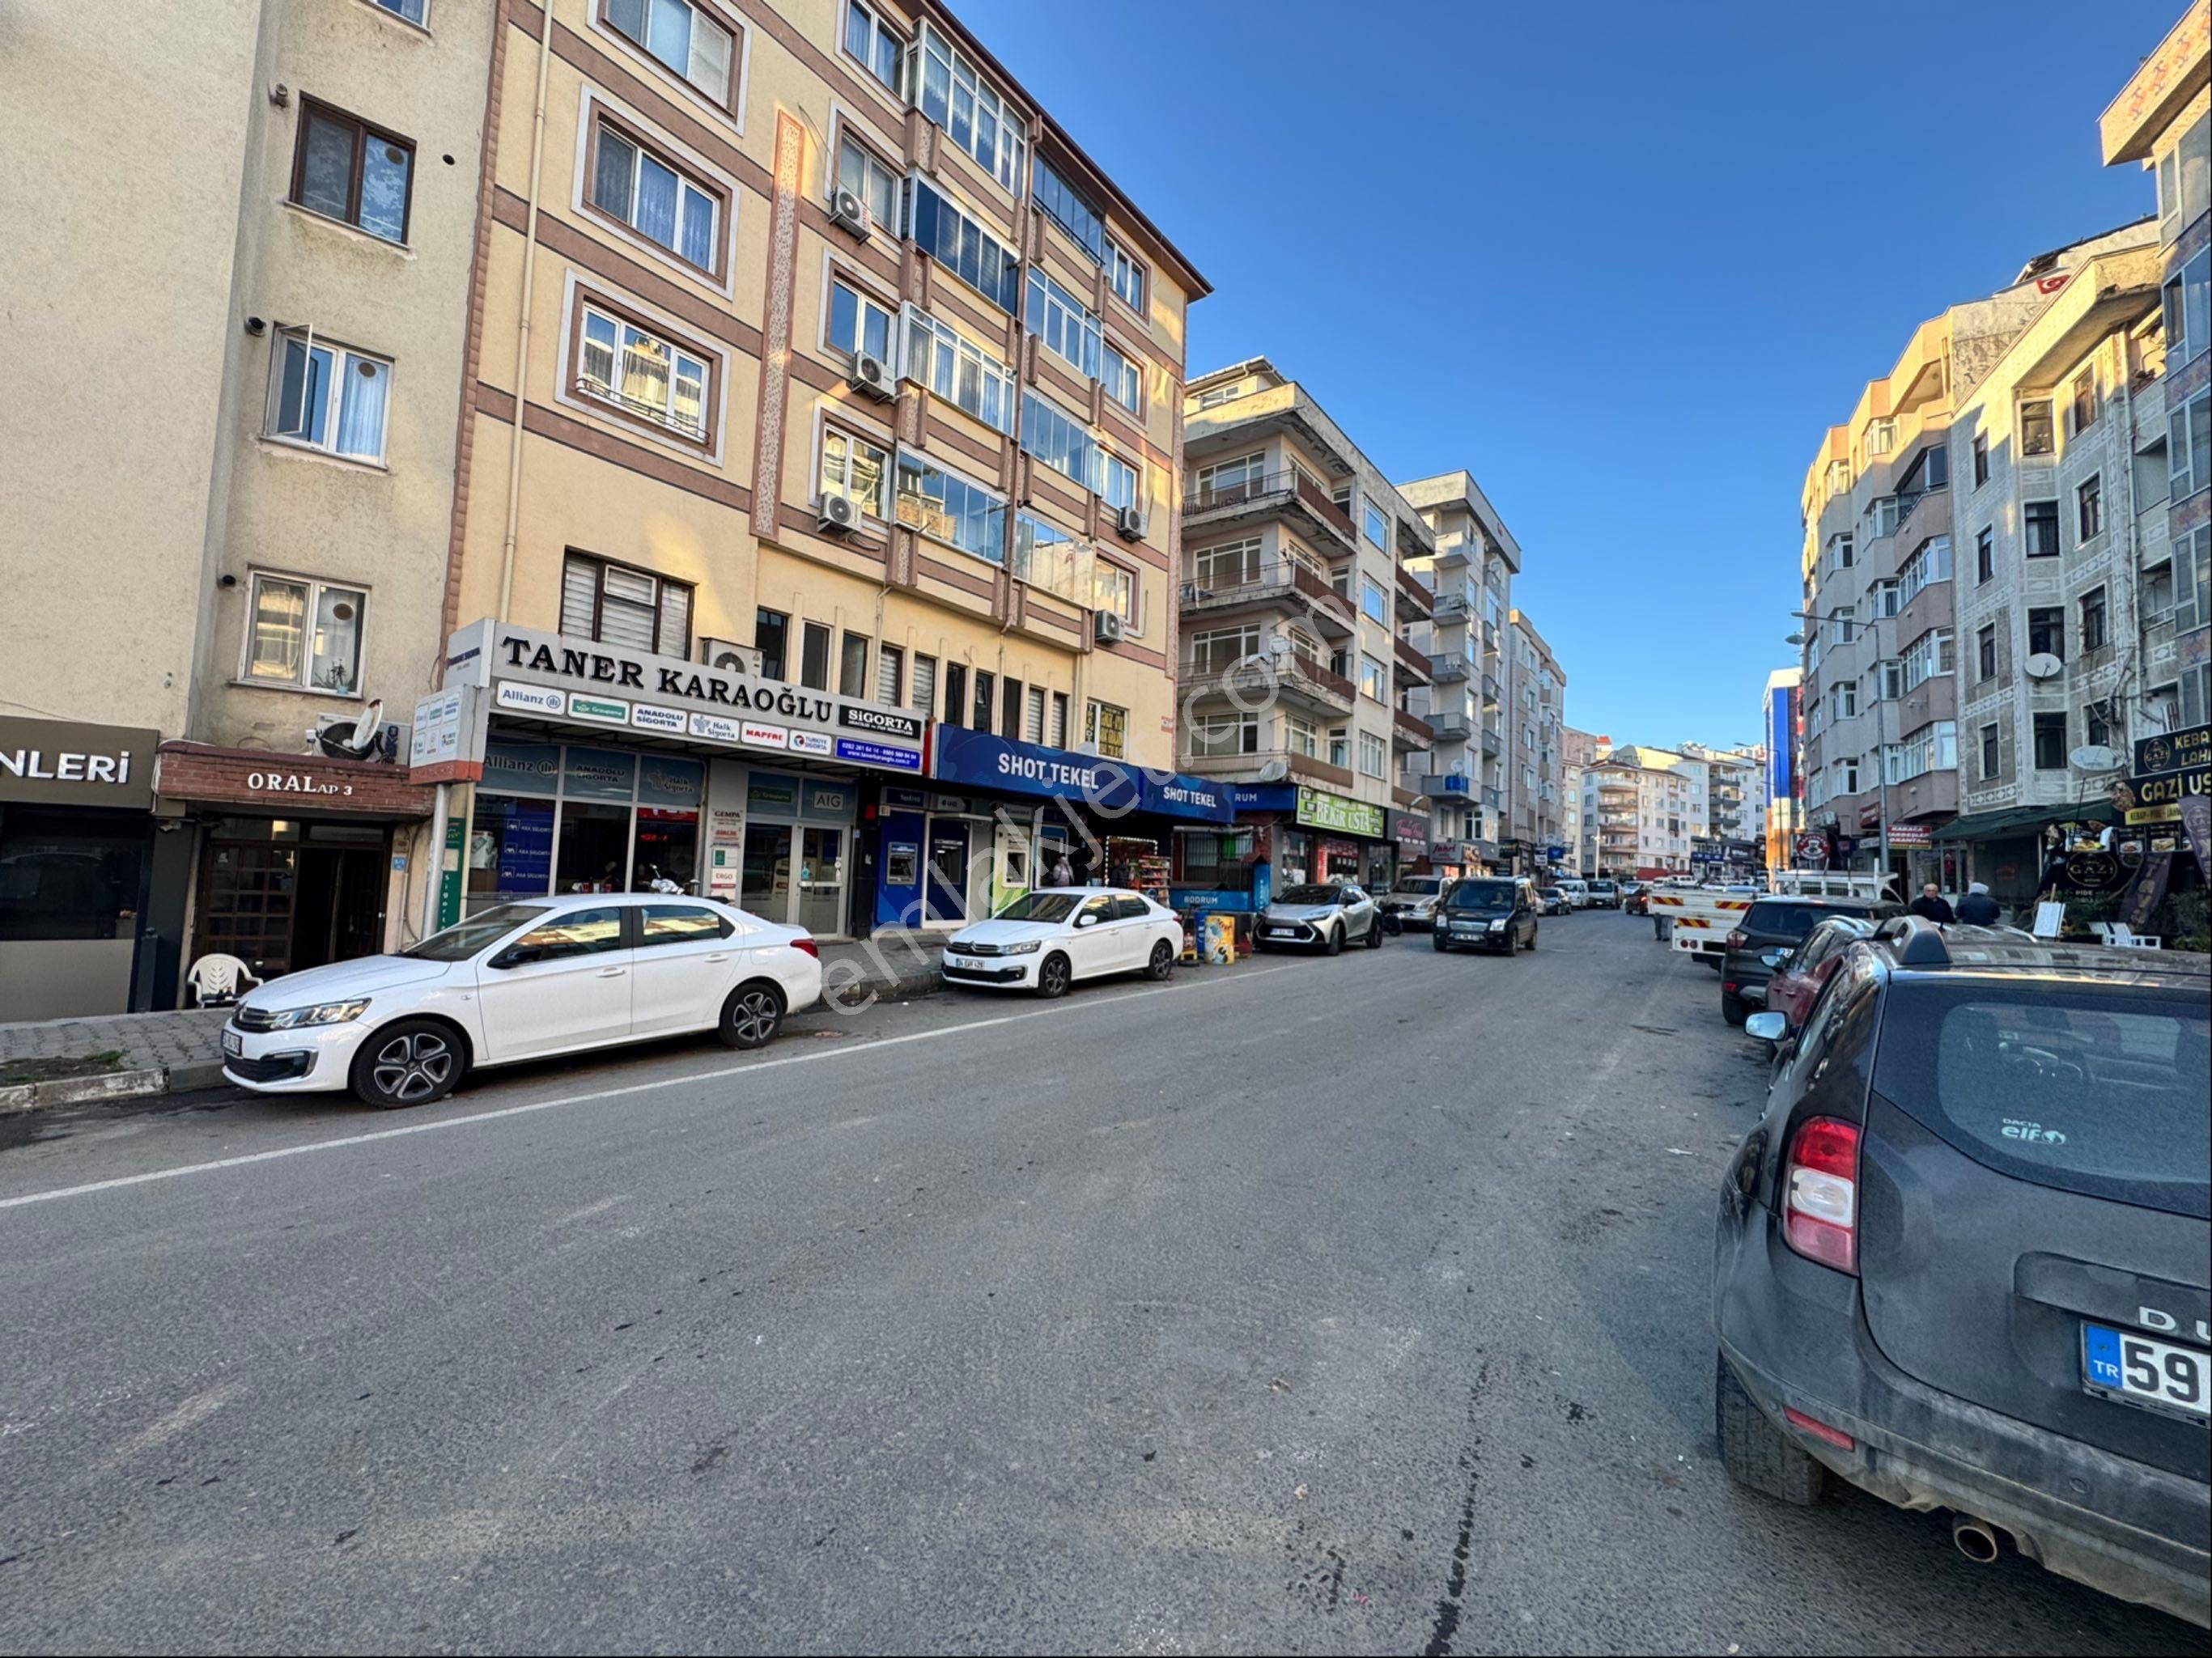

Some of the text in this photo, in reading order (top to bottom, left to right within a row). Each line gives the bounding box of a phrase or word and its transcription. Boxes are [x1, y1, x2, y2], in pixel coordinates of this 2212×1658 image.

[502, 636, 832, 723] TANER KARAOĞLU
[503, 689, 543, 705] Allianz
[637, 708, 683, 721] ANADOLU
[707, 728, 735, 739] Sigorta
[713, 722, 731, 731] Halk
[746, 729, 783, 741] MAPFRE
[484, 755, 533, 771] Allianz
[998, 753, 1099, 789] SHOT TEKEL
[248, 772, 353, 795] ORAL AP 3
[2141, 773, 2183, 802] GAZİ
[816, 794, 841, 808] AIG
[1163, 787, 1216, 808] SHOT TEKEL
[1184, 896, 1217, 904] BODRUM
[2002, 1117, 2041, 1128] DACIA
[2002, 1126, 2042, 1140] elf
[2093, 1340, 2200, 1403] TR 59
